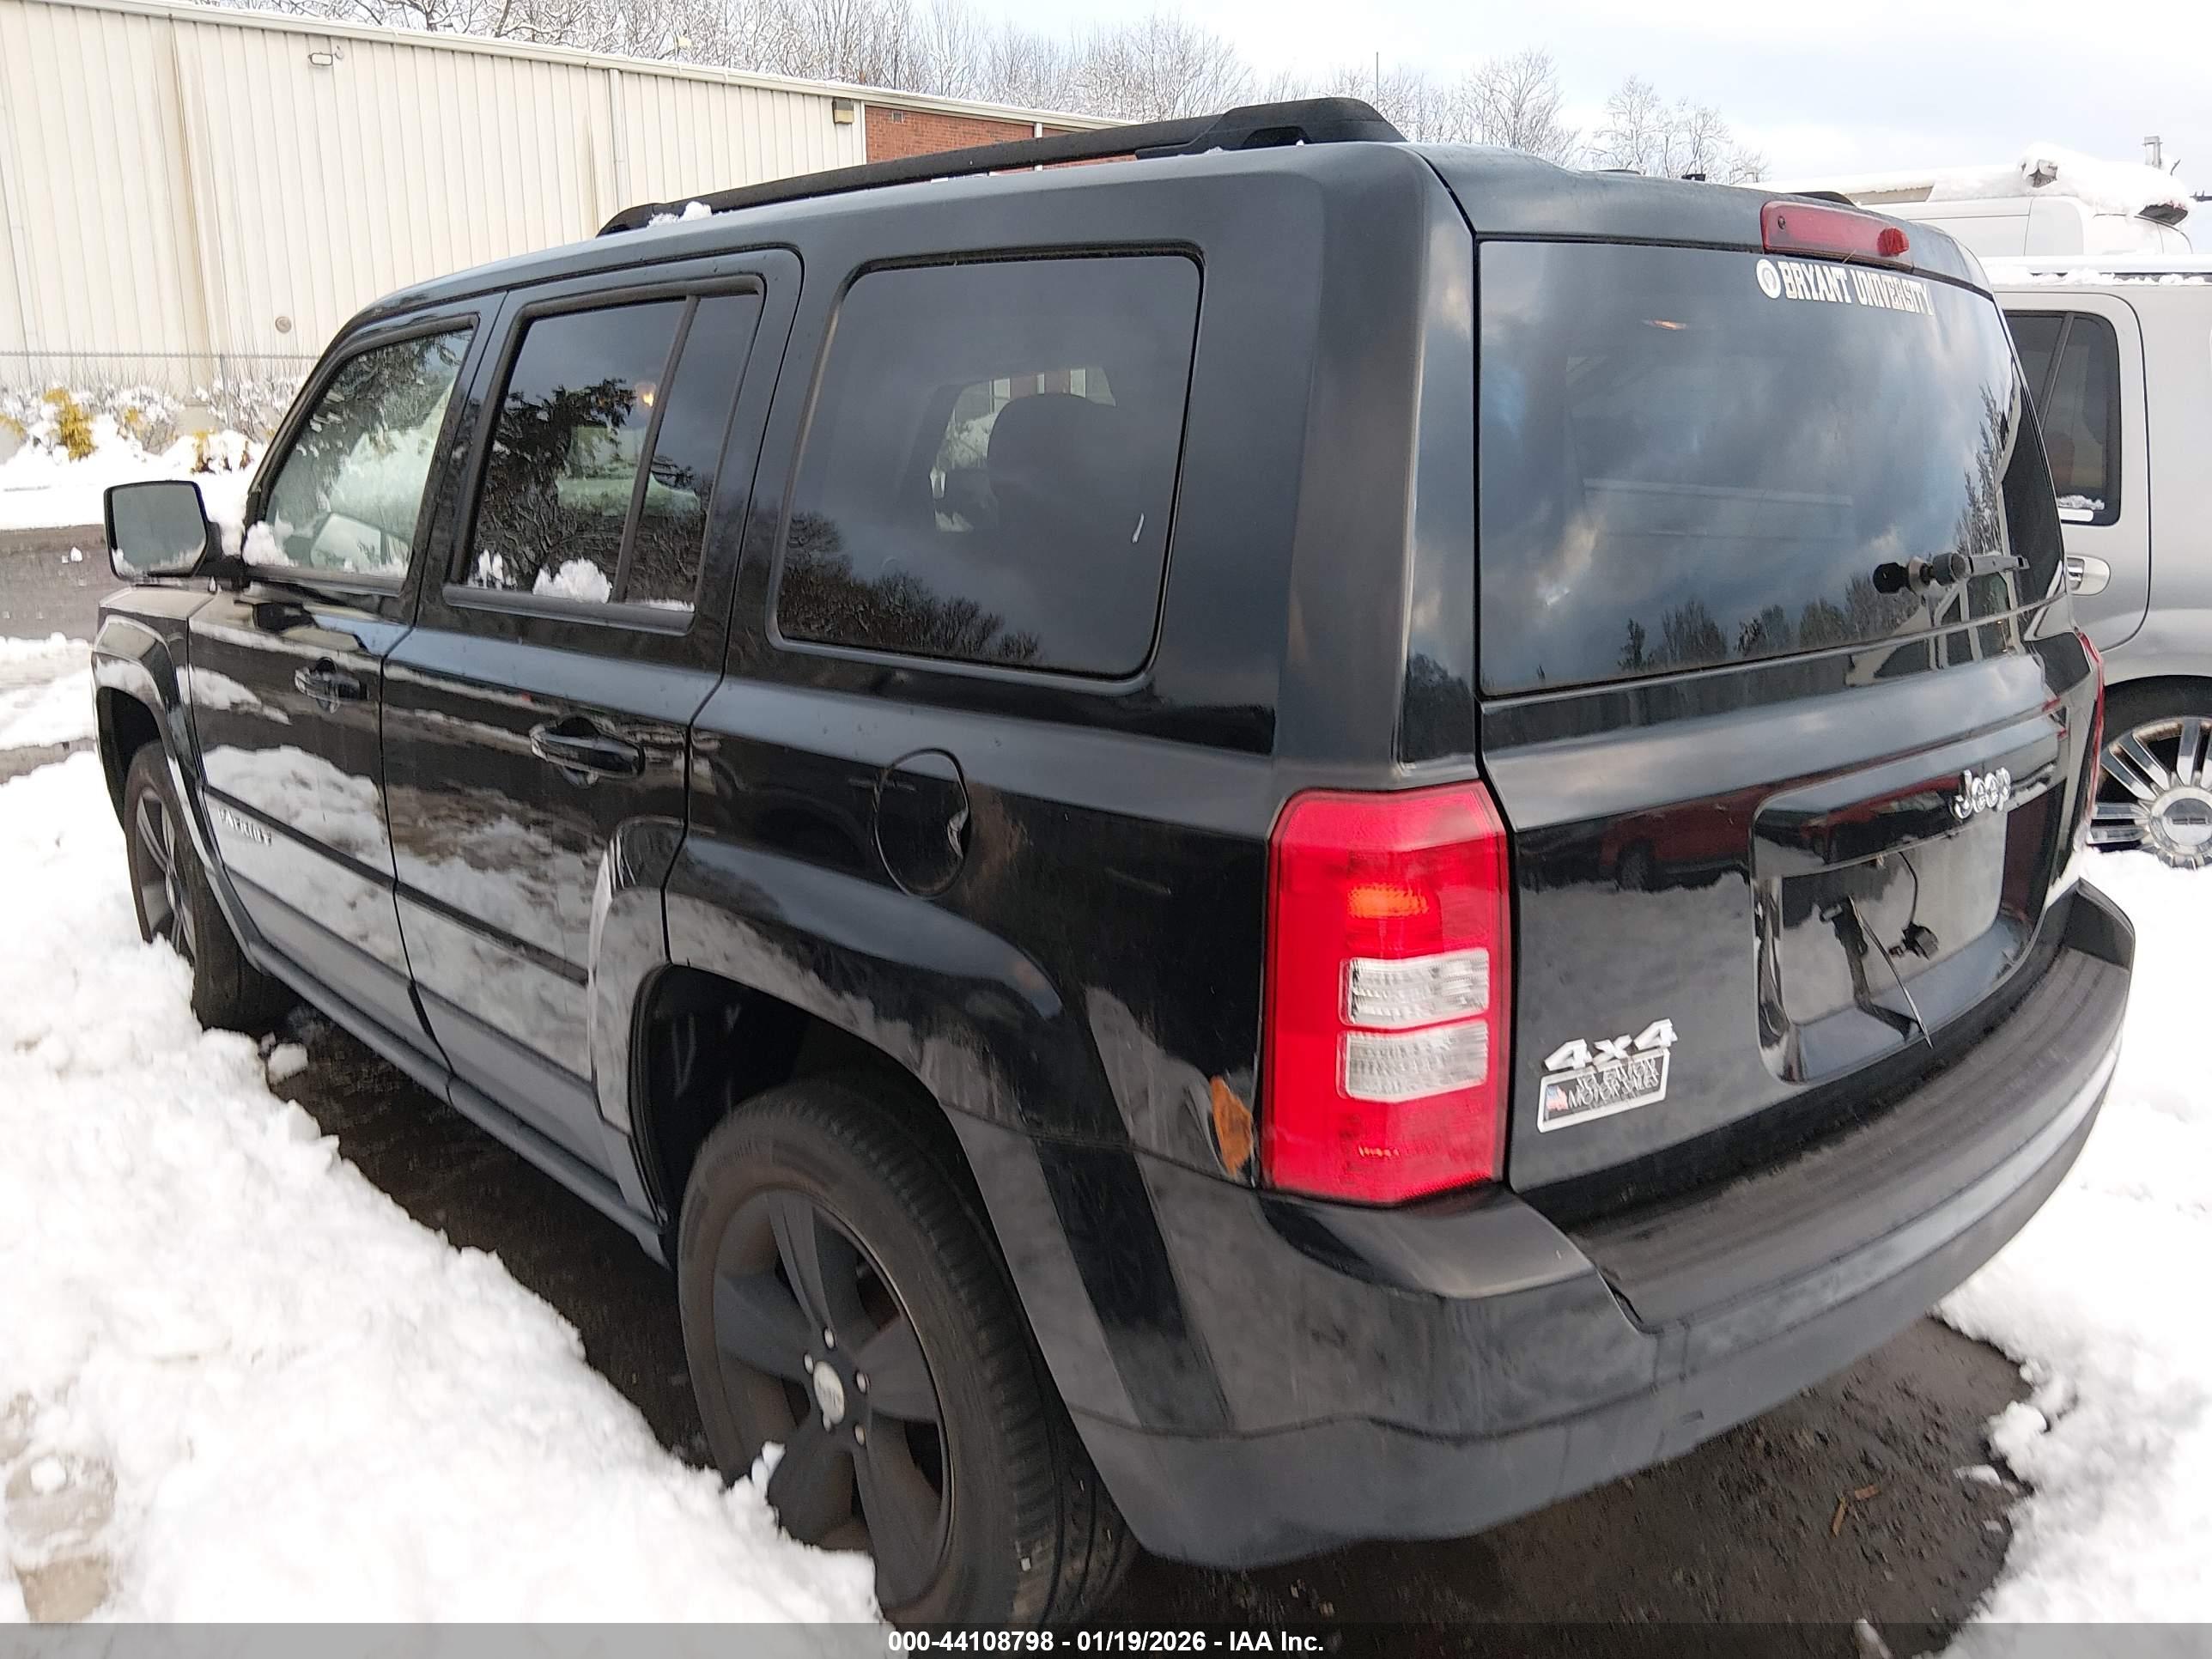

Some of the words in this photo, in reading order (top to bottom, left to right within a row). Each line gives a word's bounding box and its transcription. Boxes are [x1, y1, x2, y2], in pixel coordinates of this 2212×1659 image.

[1778, 261, 1852, 304] BRYANT
[1849, 269, 1935, 315] UNIVERSITY
[1954, 767, 2011, 819] Jeep
